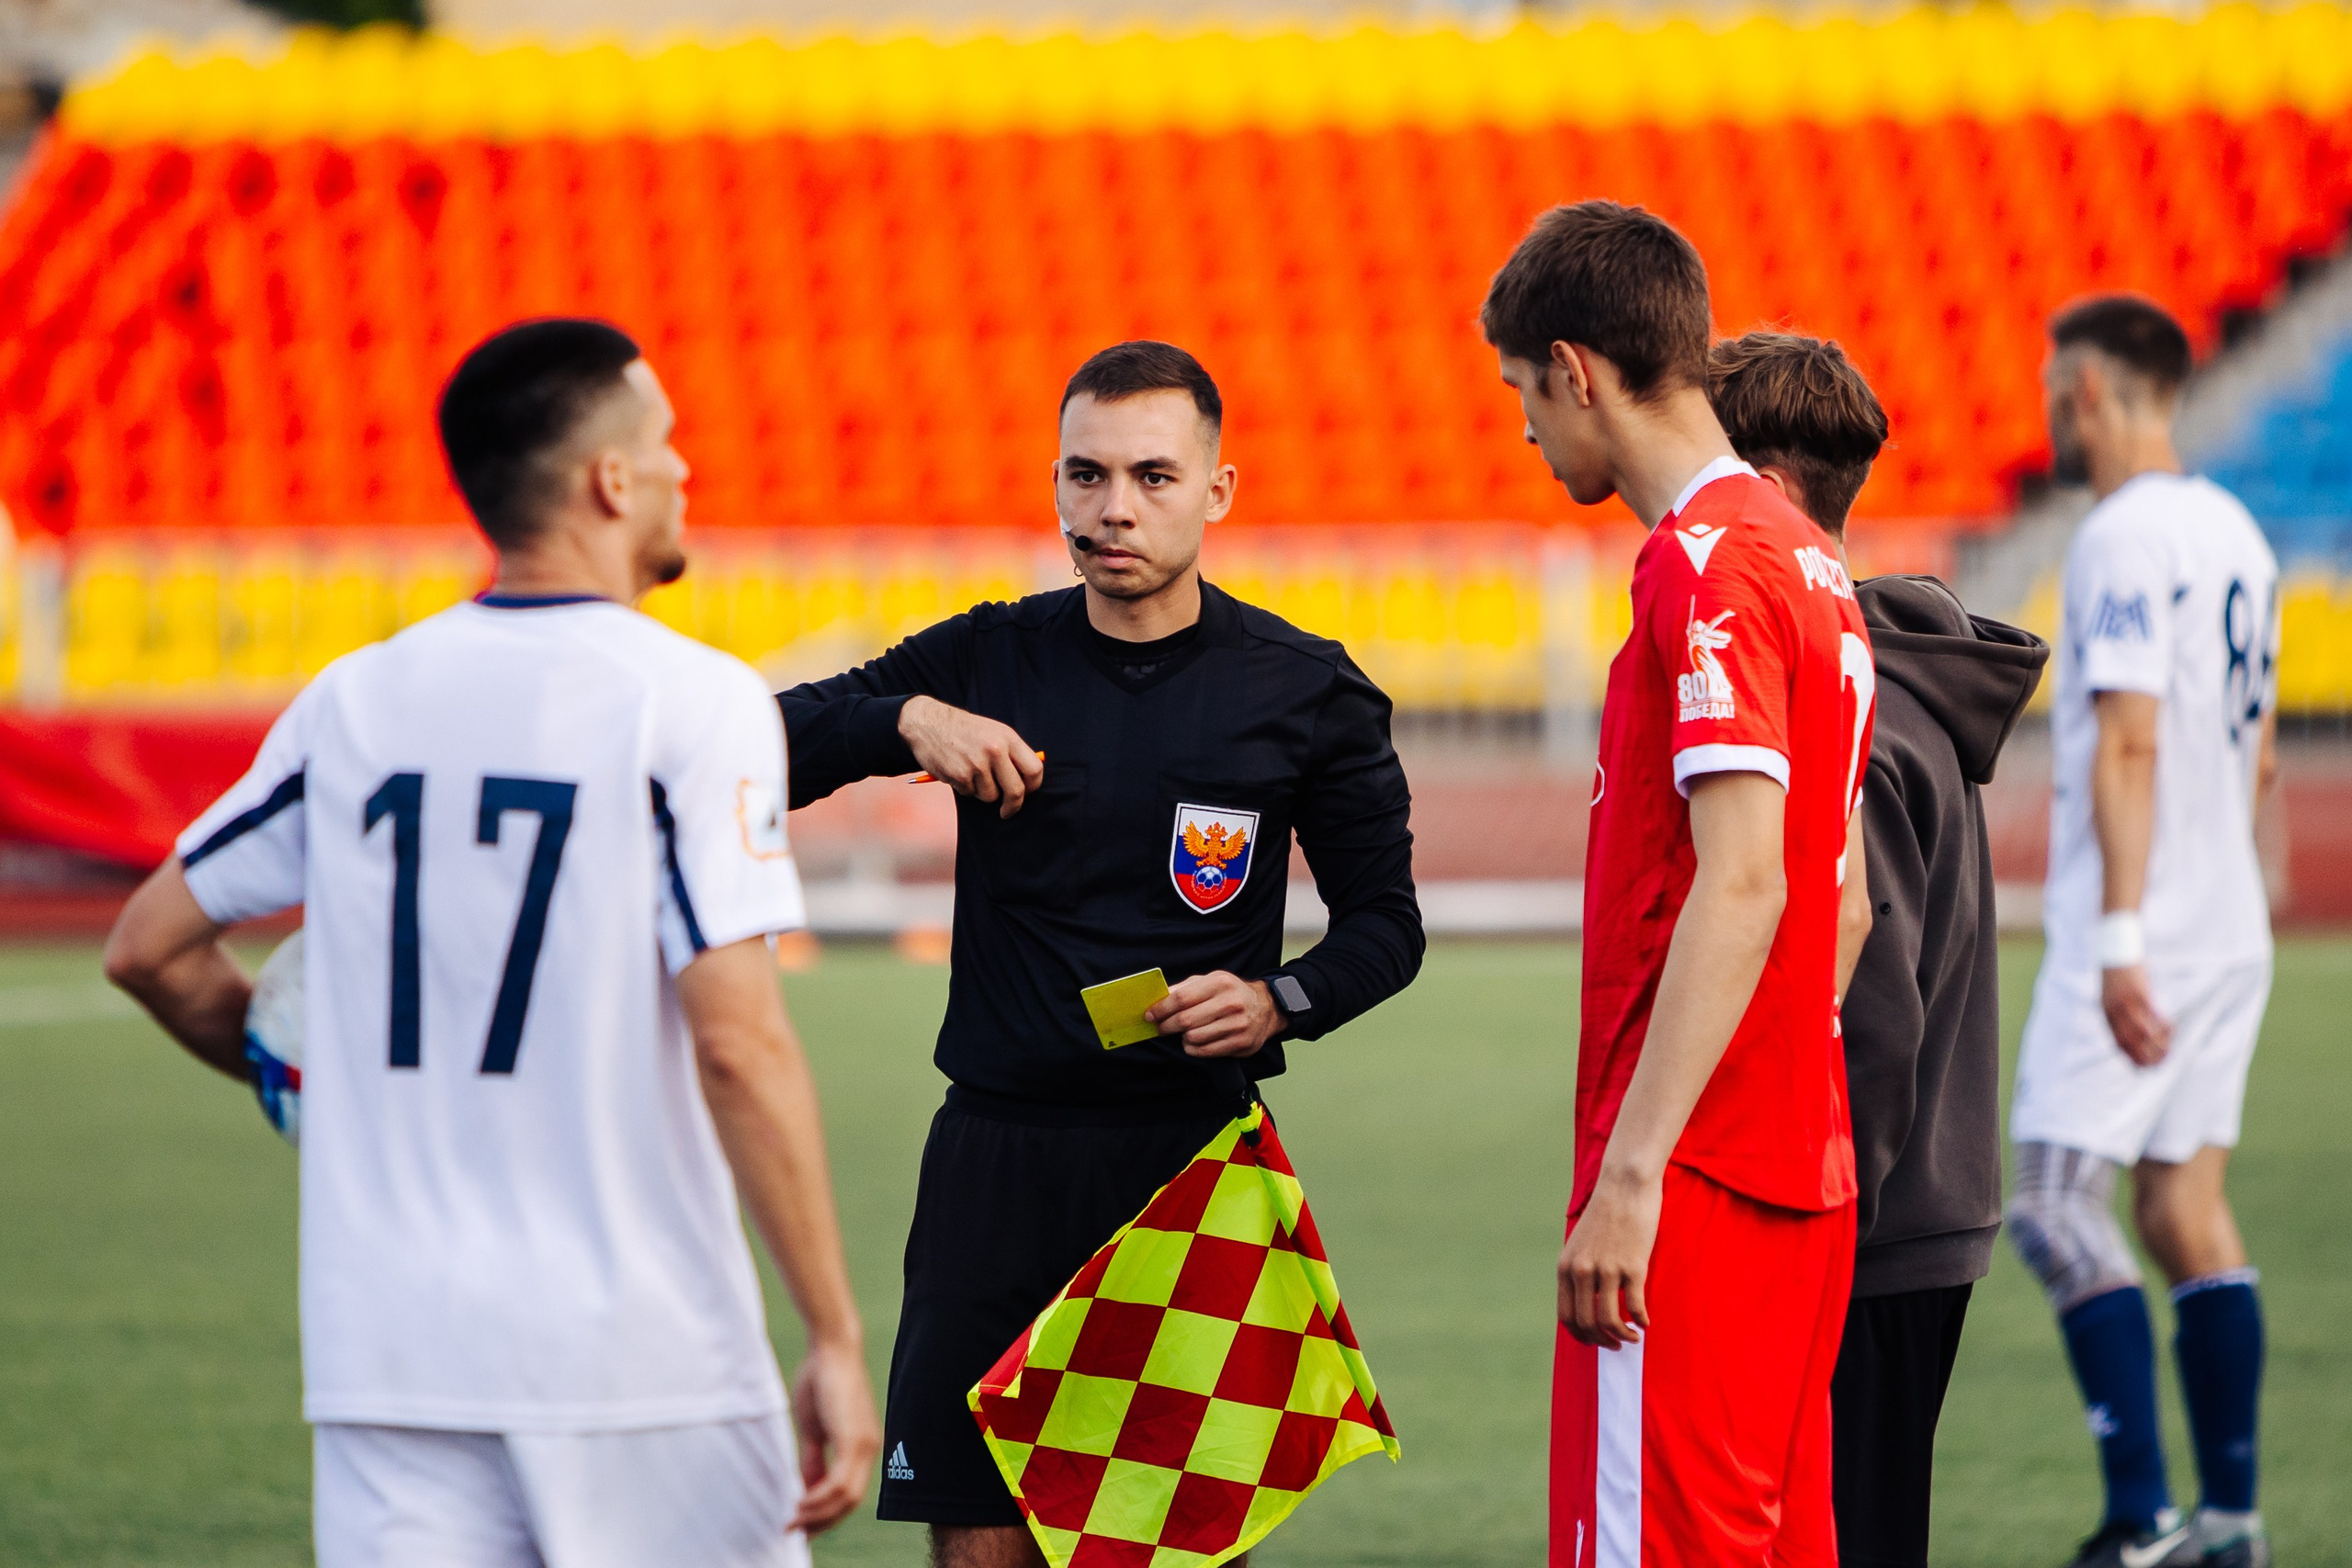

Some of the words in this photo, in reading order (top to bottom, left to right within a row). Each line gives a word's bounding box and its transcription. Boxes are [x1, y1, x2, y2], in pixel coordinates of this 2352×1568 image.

[1678, 671, 1707, 704] 80
[1679, 702, 1735, 723] ПОБЕДА!
[363, 773, 578, 1075] 17
